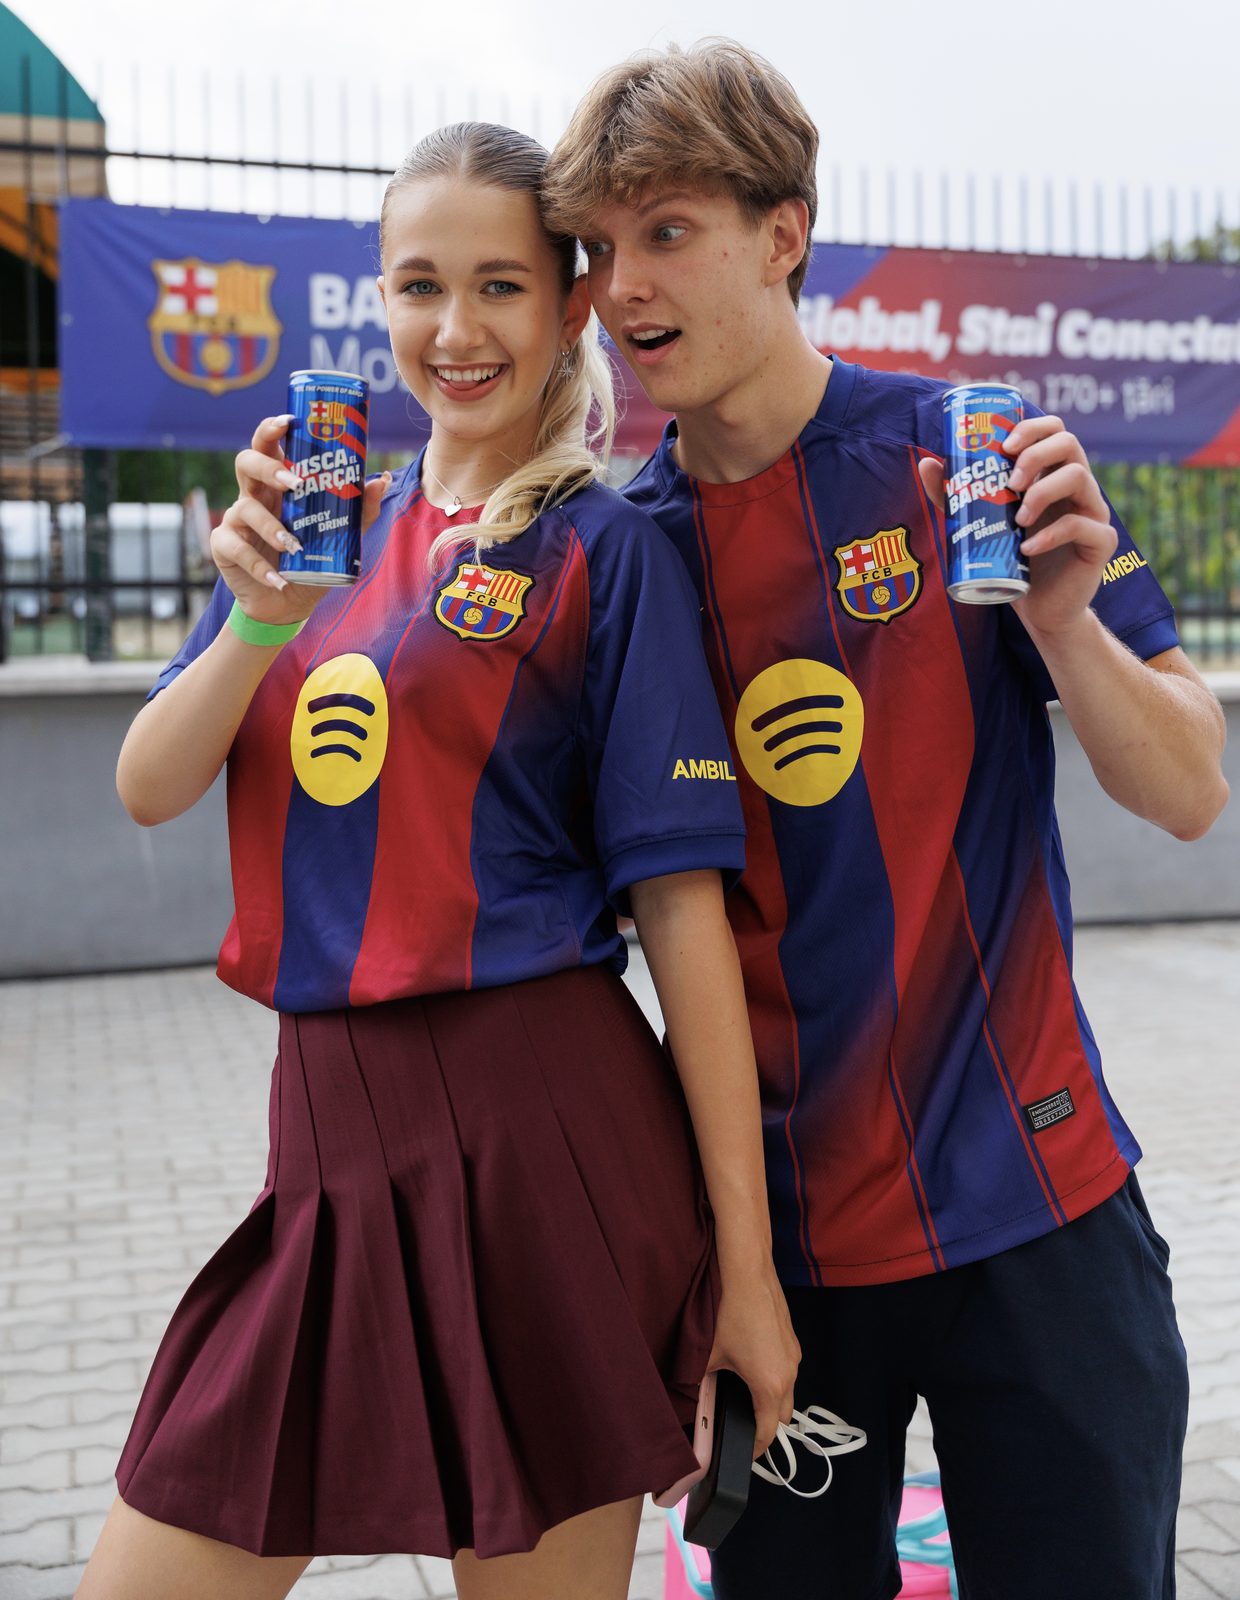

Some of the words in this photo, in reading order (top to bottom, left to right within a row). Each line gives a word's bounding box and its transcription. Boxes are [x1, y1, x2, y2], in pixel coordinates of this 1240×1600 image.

[955, 302, 1057, 357] Stai
[1057, 308, 1240, 363] Conecta
[310, 334, 410, 394] Mo
[290, 448, 348, 478] VISCA
[946, 456, 1000, 498] VISCA
[294, 464, 360, 501] BARÇA!
[949, 470, 1014, 516] BARÇA
[293, 510, 331, 531] ENERGY
[318, 515, 349, 533] DRINK
[952, 517, 986, 544] ENERGY
[974, 520, 1007, 540] DRINK
[861, 567, 892, 583] FCB
[1102, 550, 1148, 585] AMBIL
[465, 591, 498, 607] FCB
[671, 758, 737, 781] AMBIL
